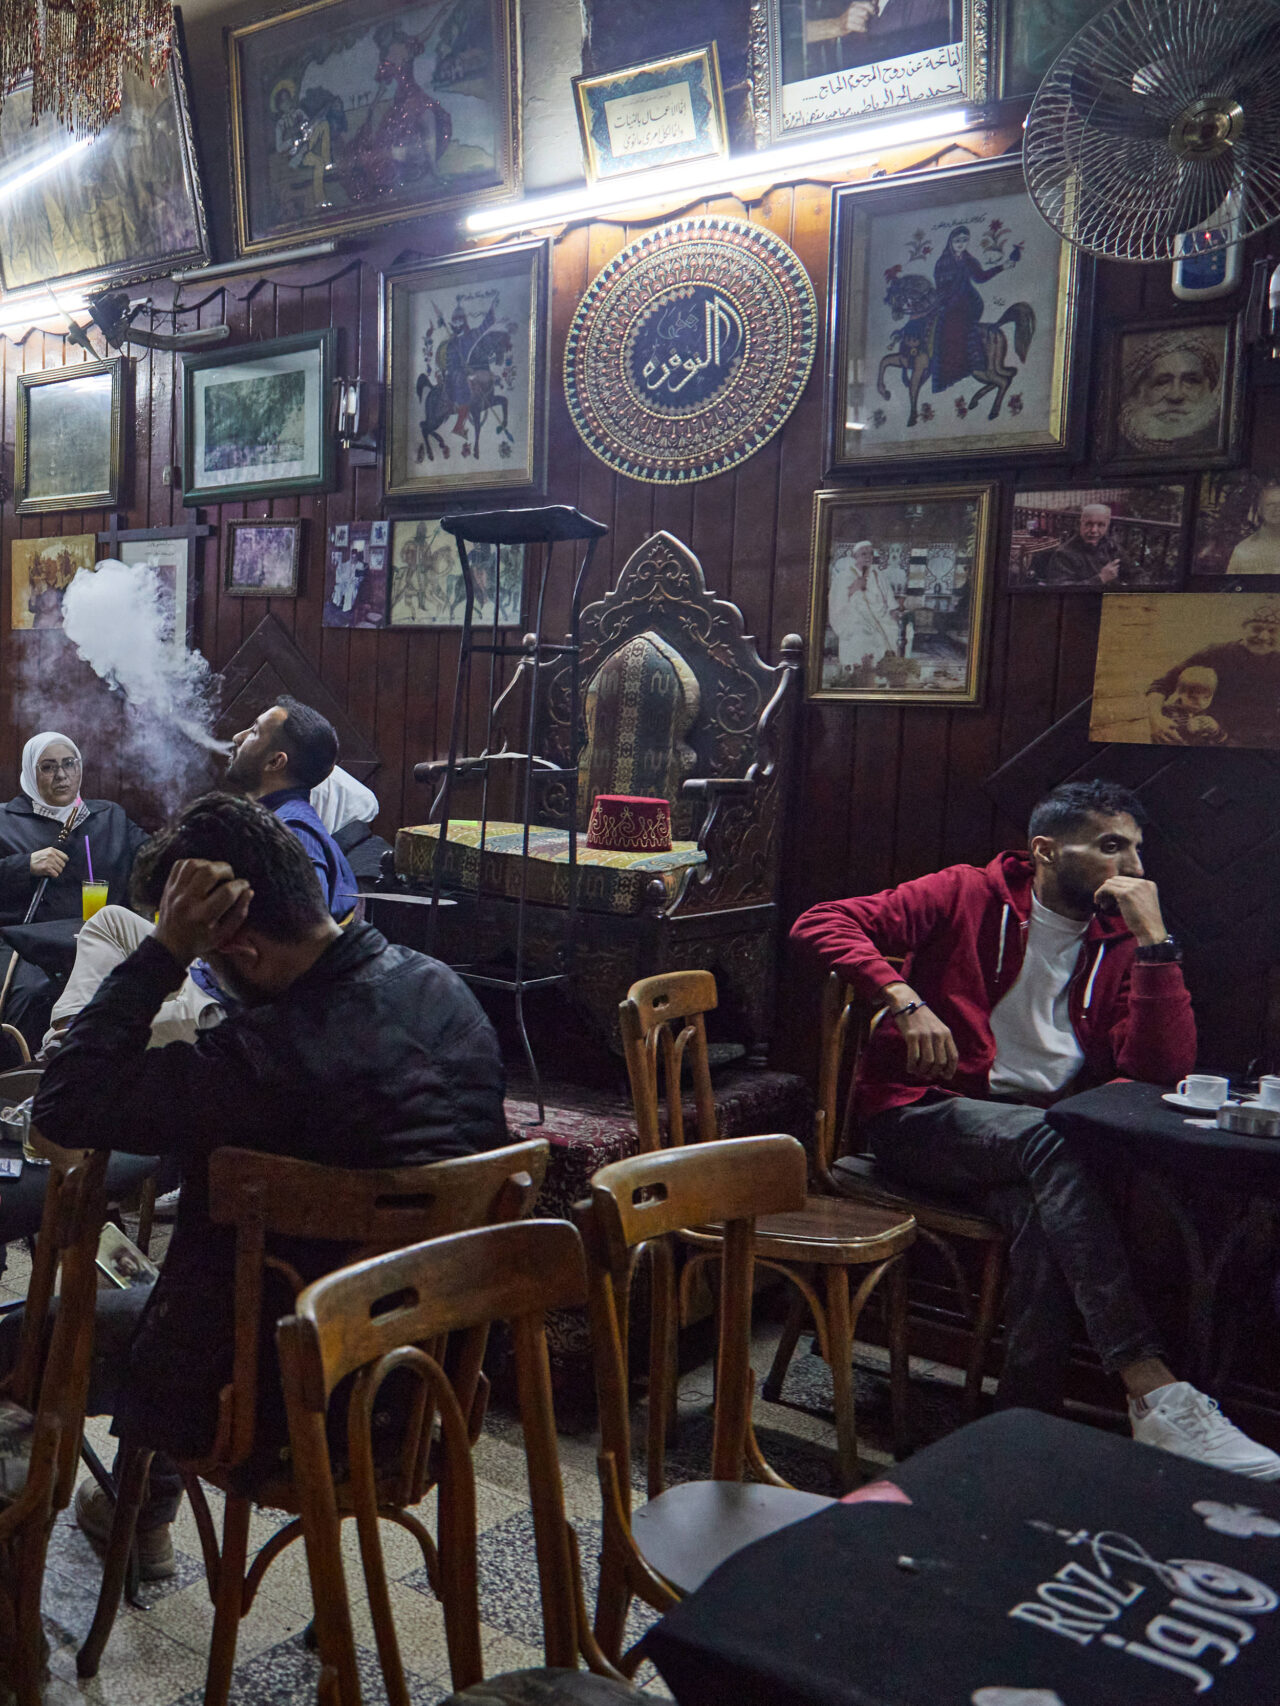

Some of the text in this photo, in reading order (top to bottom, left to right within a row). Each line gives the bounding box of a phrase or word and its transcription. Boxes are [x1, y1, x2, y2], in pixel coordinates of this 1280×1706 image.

[906, 61, 923, 76] عن
[923, 45, 964, 70] الفاتحة
[847, 63, 882, 92] المرحوم
[882, 67, 906, 84] روح
[1007, 1560, 1148, 1647] ROZ
